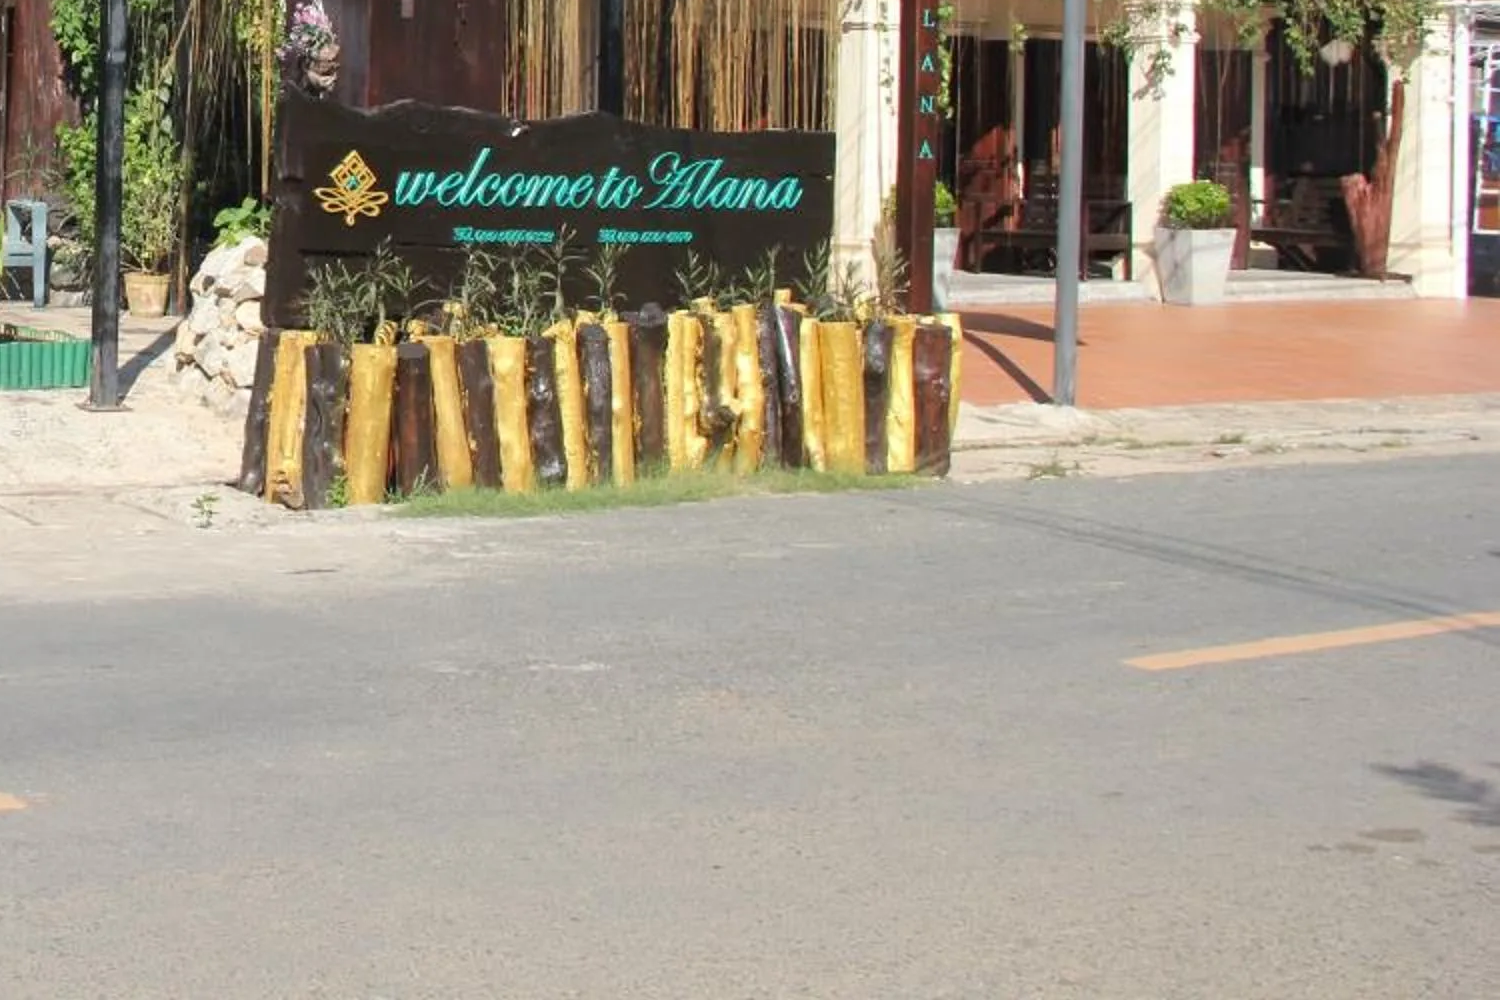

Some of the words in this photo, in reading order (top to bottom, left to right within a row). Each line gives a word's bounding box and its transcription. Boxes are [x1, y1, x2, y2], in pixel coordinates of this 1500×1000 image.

[393, 146, 595, 209] welcome
[595, 165, 643, 209] to
[643, 150, 803, 209] Alana
